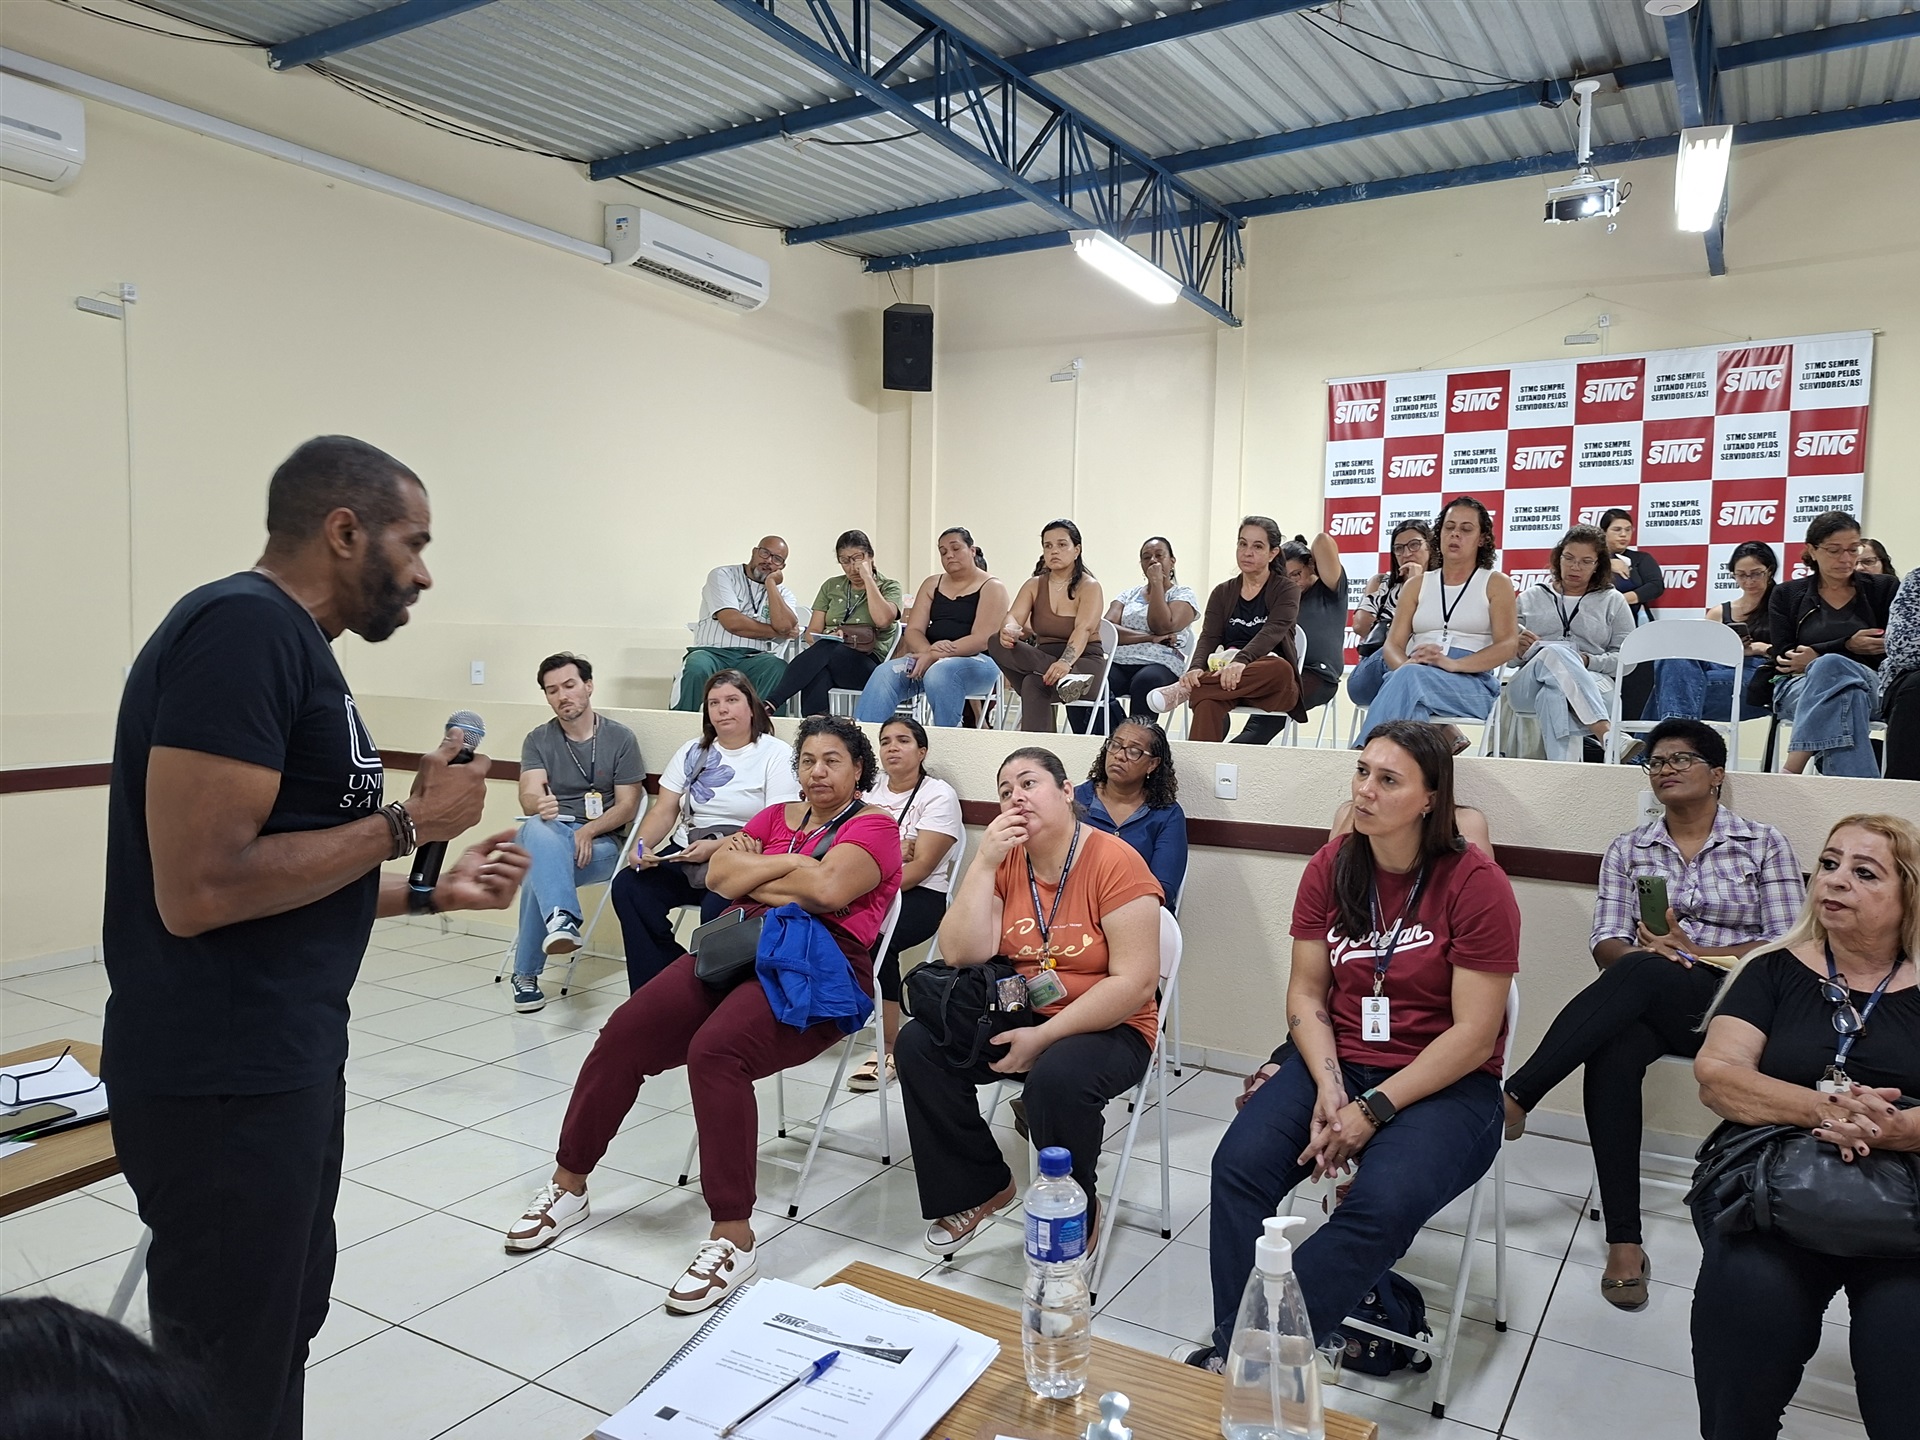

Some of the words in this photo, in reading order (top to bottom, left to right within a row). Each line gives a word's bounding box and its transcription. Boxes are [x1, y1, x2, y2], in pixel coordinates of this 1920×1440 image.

[1805, 362, 1826, 370] STMC
[1828, 359, 1859, 368] SEMPRE
[1656, 374, 1676, 382] STMC
[1678, 372, 1705, 380] SEMPRE
[1723, 364, 1785, 393] STMC
[1802, 371, 1835, 380] LUTANDO
[1838, 369, 1860, 377] PELOS
[1540, 383, 1564, 391] SEMPRE
[1582, 376, 1638, 403] STMC
[1654, 383, 1684, 392] LUTANDO
[1686, 381, 1706, 389] PELOS
[1451, 387, 1503, 413] STMC
[1518, 394, 1546, 402] LUTANDO
[1547, 392, 1566, 400] PELOS
[1334, 398, 1381, 425] STMC
[1393, 404, 1418, 412] LUTANDO
[1726, 433, 1746, 441] STMC
[1748, 431, 1776, 440] SEMPRE
[1794, 428, 1859, 457] STMC
[1472, 448, 1496, 456] SEMPRE
[1512, 445, 1567, 470] STMC
[1647, 438, 1706, 464] STMC
[1333, 469, 1356, 477] LUTANDO
[1388, 454, 1438, 478] STMC
[1821, 494, 1852, 502] SEMPRE
[1717, 500, 1779, 526] STMC
[1796, 505, 1829, 513] LUTANDO
[1831, 504, 1854, 512] PELOS
[1329, 512, 1376, 536] STMC
[348, 773, 383, 790] UNI
[771, 1312, 809, 1329] STMC
